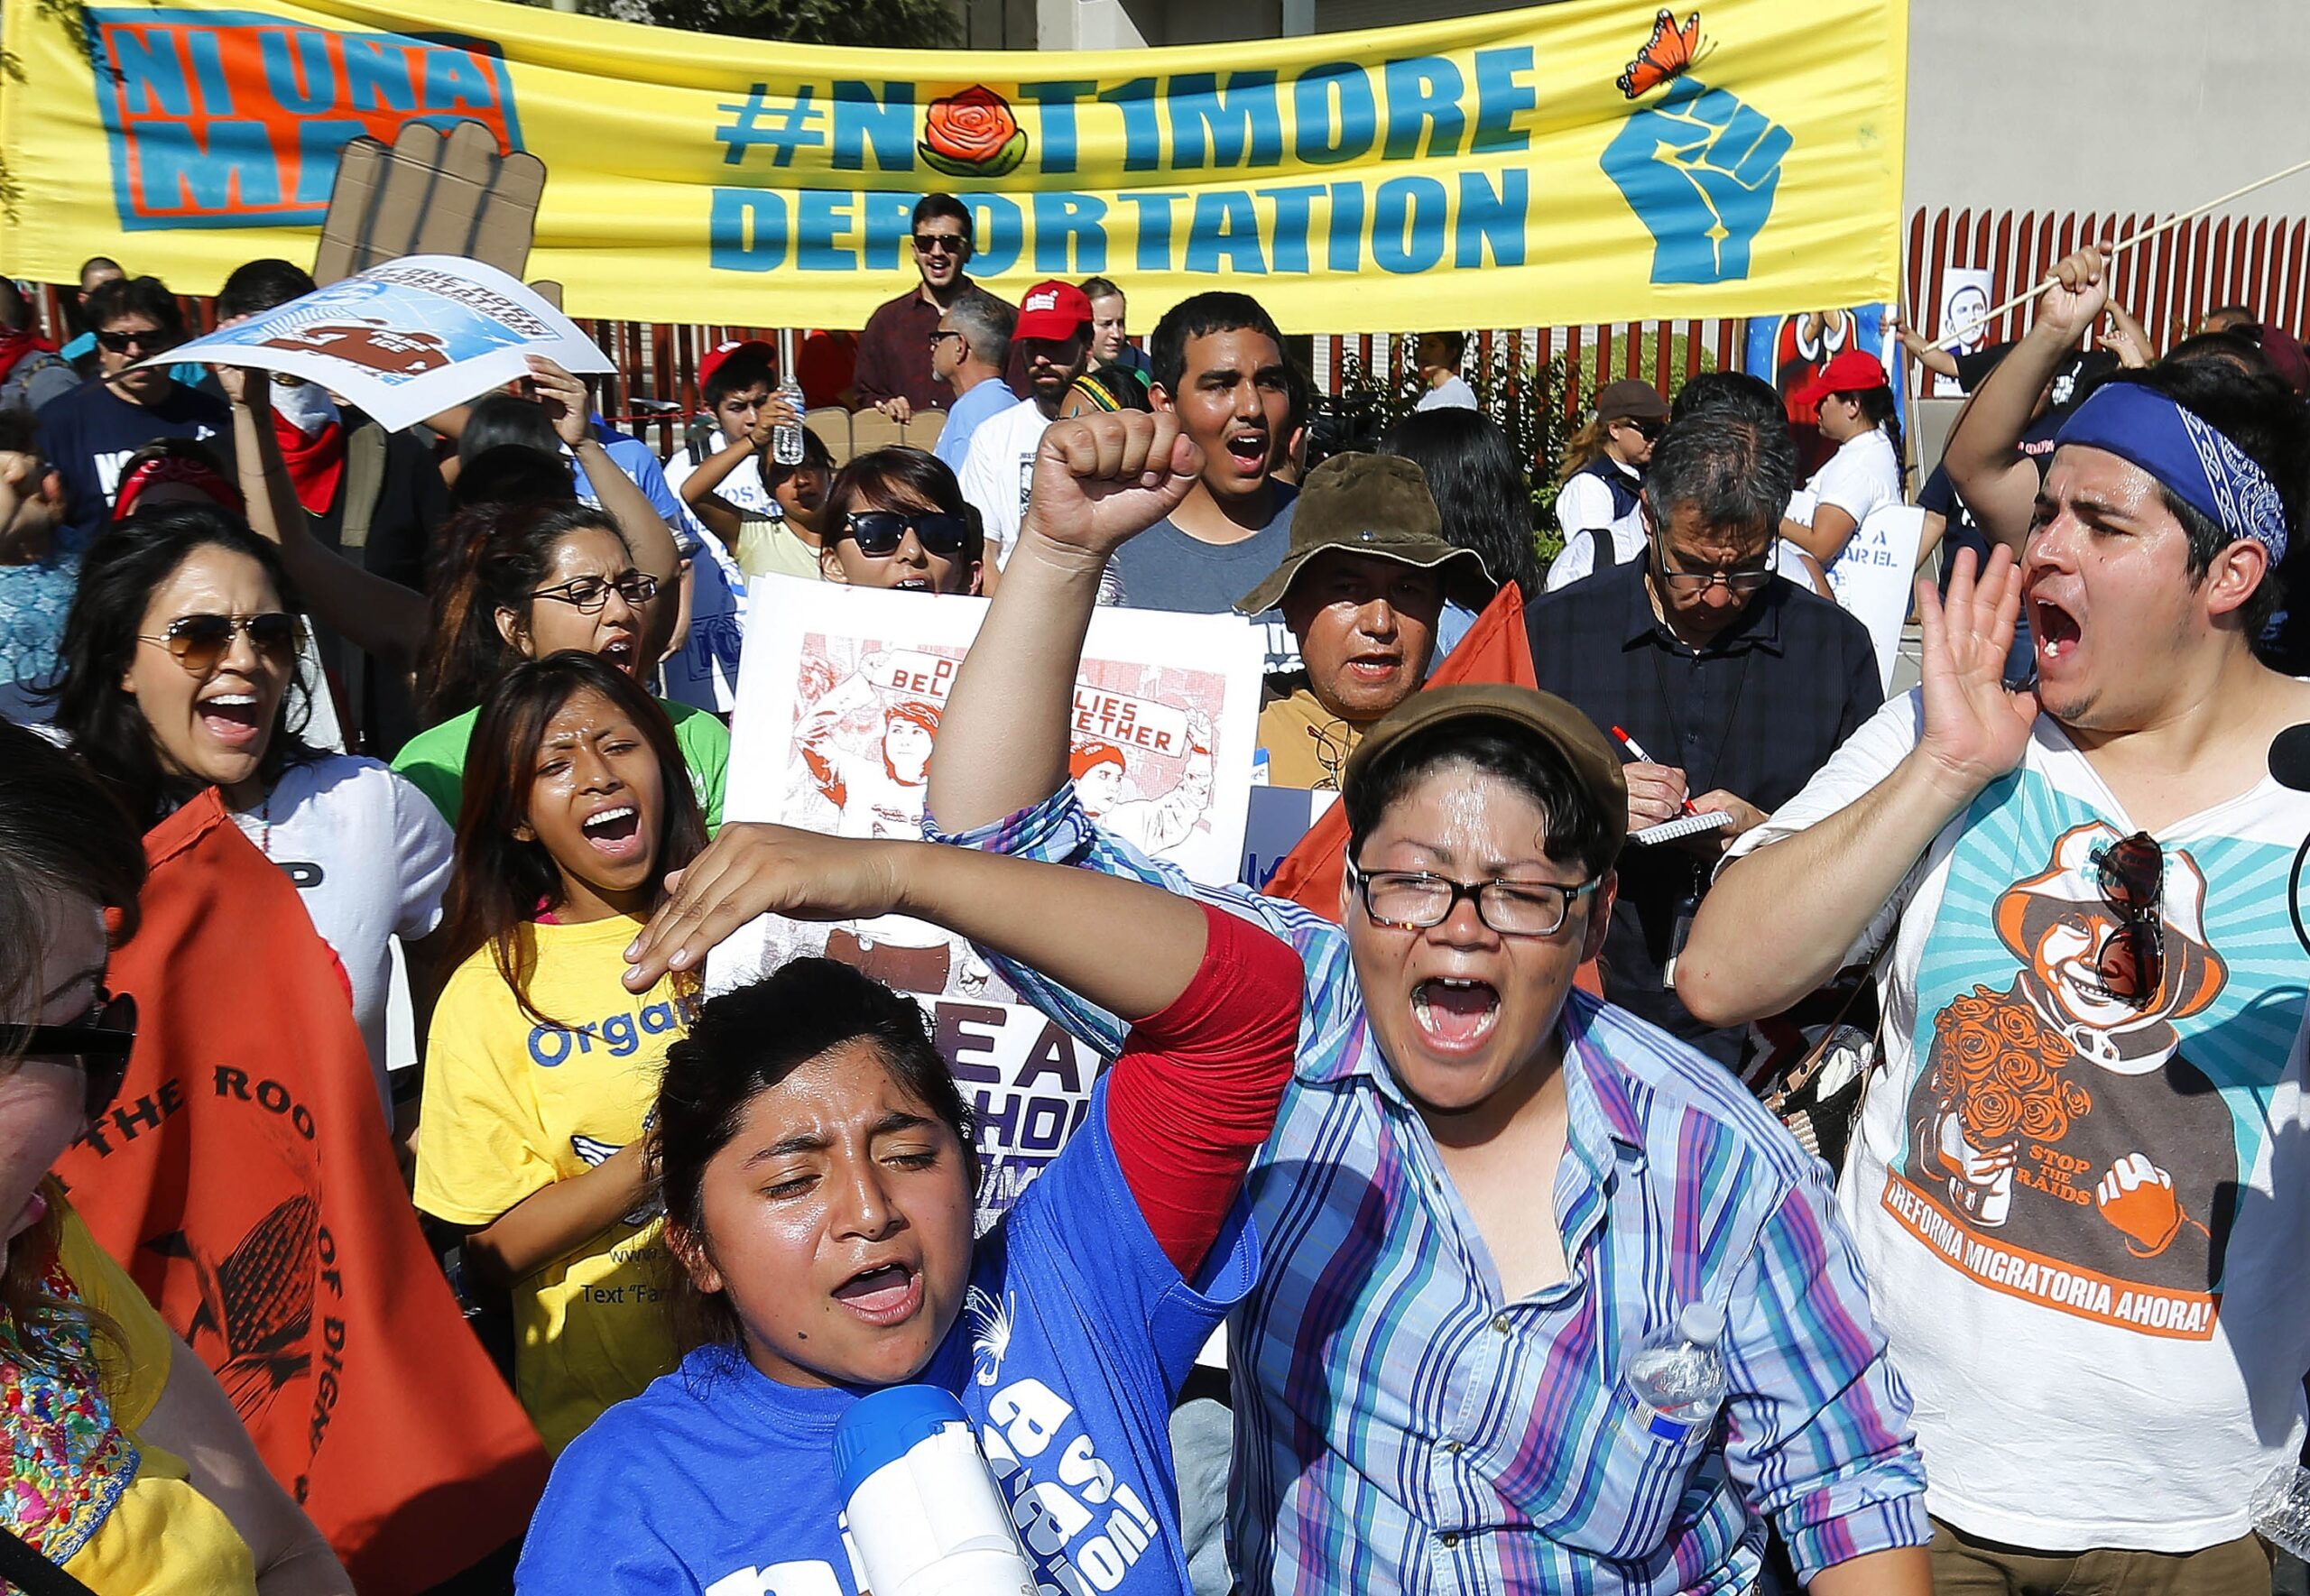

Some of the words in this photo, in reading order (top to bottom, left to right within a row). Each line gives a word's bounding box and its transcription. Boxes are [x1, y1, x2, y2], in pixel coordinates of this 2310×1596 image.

[112, 29, 234, 117] NI
[258, 31, 495, 115] UNA
[710, 169, 1529, 277] DEPORTATION
[473, 287, 550, 333] MORE
[366, 337, 410, 354] ICE
[892, 669, 945, 697] BEL
[1072, 709, 1172, 751] ETHER
[1073, 690, 1138, 721] LIES
[71, 1077, 184, 1159] THE
[212, 1065, 316, 1141] ROO
[975, 1090, 1090, 1150] HO
[2015, 1167, 2092, 1206] RAIDS
[2028, 1144, 2093, 1175] STOP
[2039, 1164, 2073, 1184] THE
[318, 1225, 344, 1300] OF
[1963, 1239, 2111, 1315] MIGRATORIA
[2113, 1291, 2213, 1333] AHORA!
[580, 1284, 624, 1304] Text
[1012, 1433, 1115, 1556] ás
